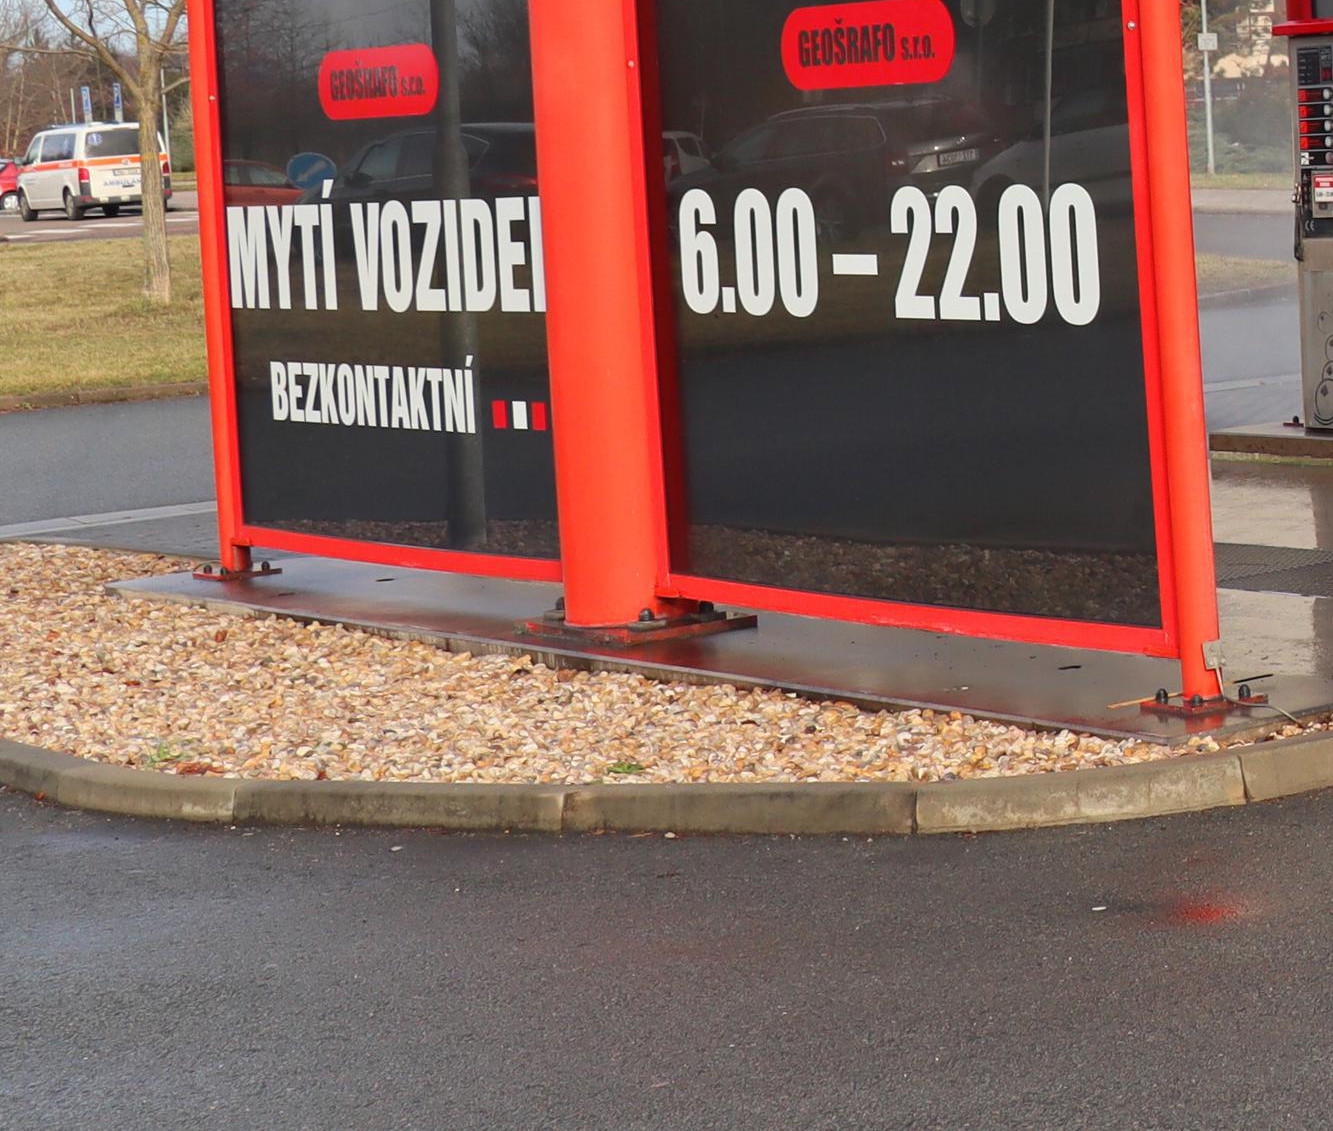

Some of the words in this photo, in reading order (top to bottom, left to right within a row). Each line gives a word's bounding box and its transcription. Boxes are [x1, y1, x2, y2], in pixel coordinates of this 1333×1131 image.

[798, 18, 896, 68] GEOŠRAFO
[901, 34, 935, 61] s.r.o.
[331, 59, 399, 102] GEOŠRAFO
[401, 76, 426, 97] s.r.o.
[103, 178, 142, 187] AMBULAN
[226, 179, 338, 311] MYTÍ
[678, 187, 819, 318] 6.00
[890, 182, 1100, 326] 22.00
[270, 355, 477, 434] BEZKONTAKTNÍ
